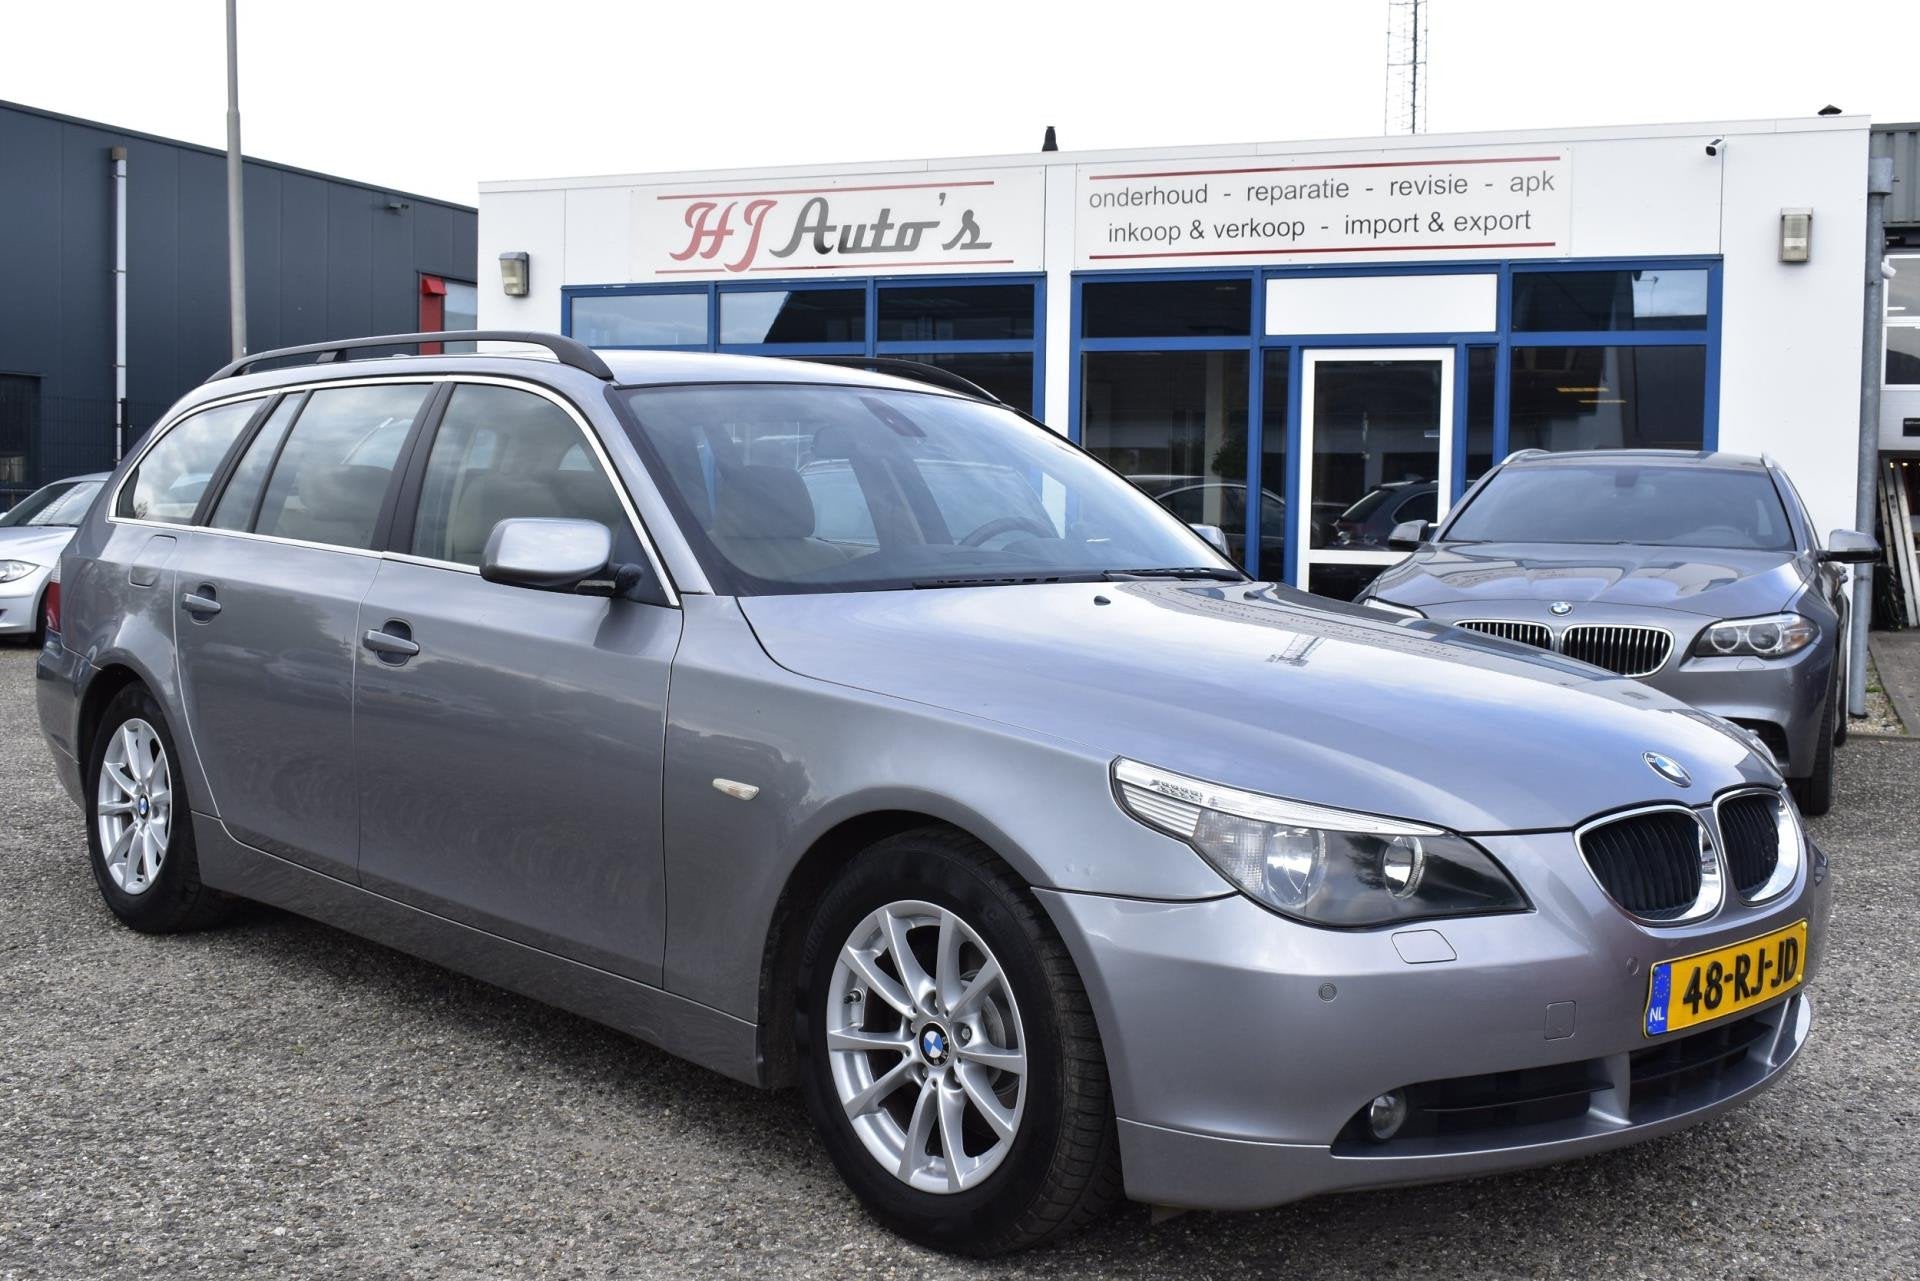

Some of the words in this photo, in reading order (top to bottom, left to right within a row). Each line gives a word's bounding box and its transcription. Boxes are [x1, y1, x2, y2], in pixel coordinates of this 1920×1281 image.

[1088, 183, 1208, 209] onderhoud
[1247, 177, 1350, 207] reparatie
[1390, 174, 1468, 197] revisie
[1509, 170, 1555, 198] apk
[668, 199, 778, 273] HJ
[768, 192, 993, 259] Auto's
[1108, 222, 1182, 246] inkoop
[1189, 219, 1205, 240] &
[1213, 220, 1306, 242] verkoop
[1345, 213, 1420, 240] import
[1427, 211, 1445, 233] &
[1453, 209, 1532, 237] export
[1683, 937, 1799, 1015] 48-RJ-JD
[1650, 1006, 1665, 1023] NL
